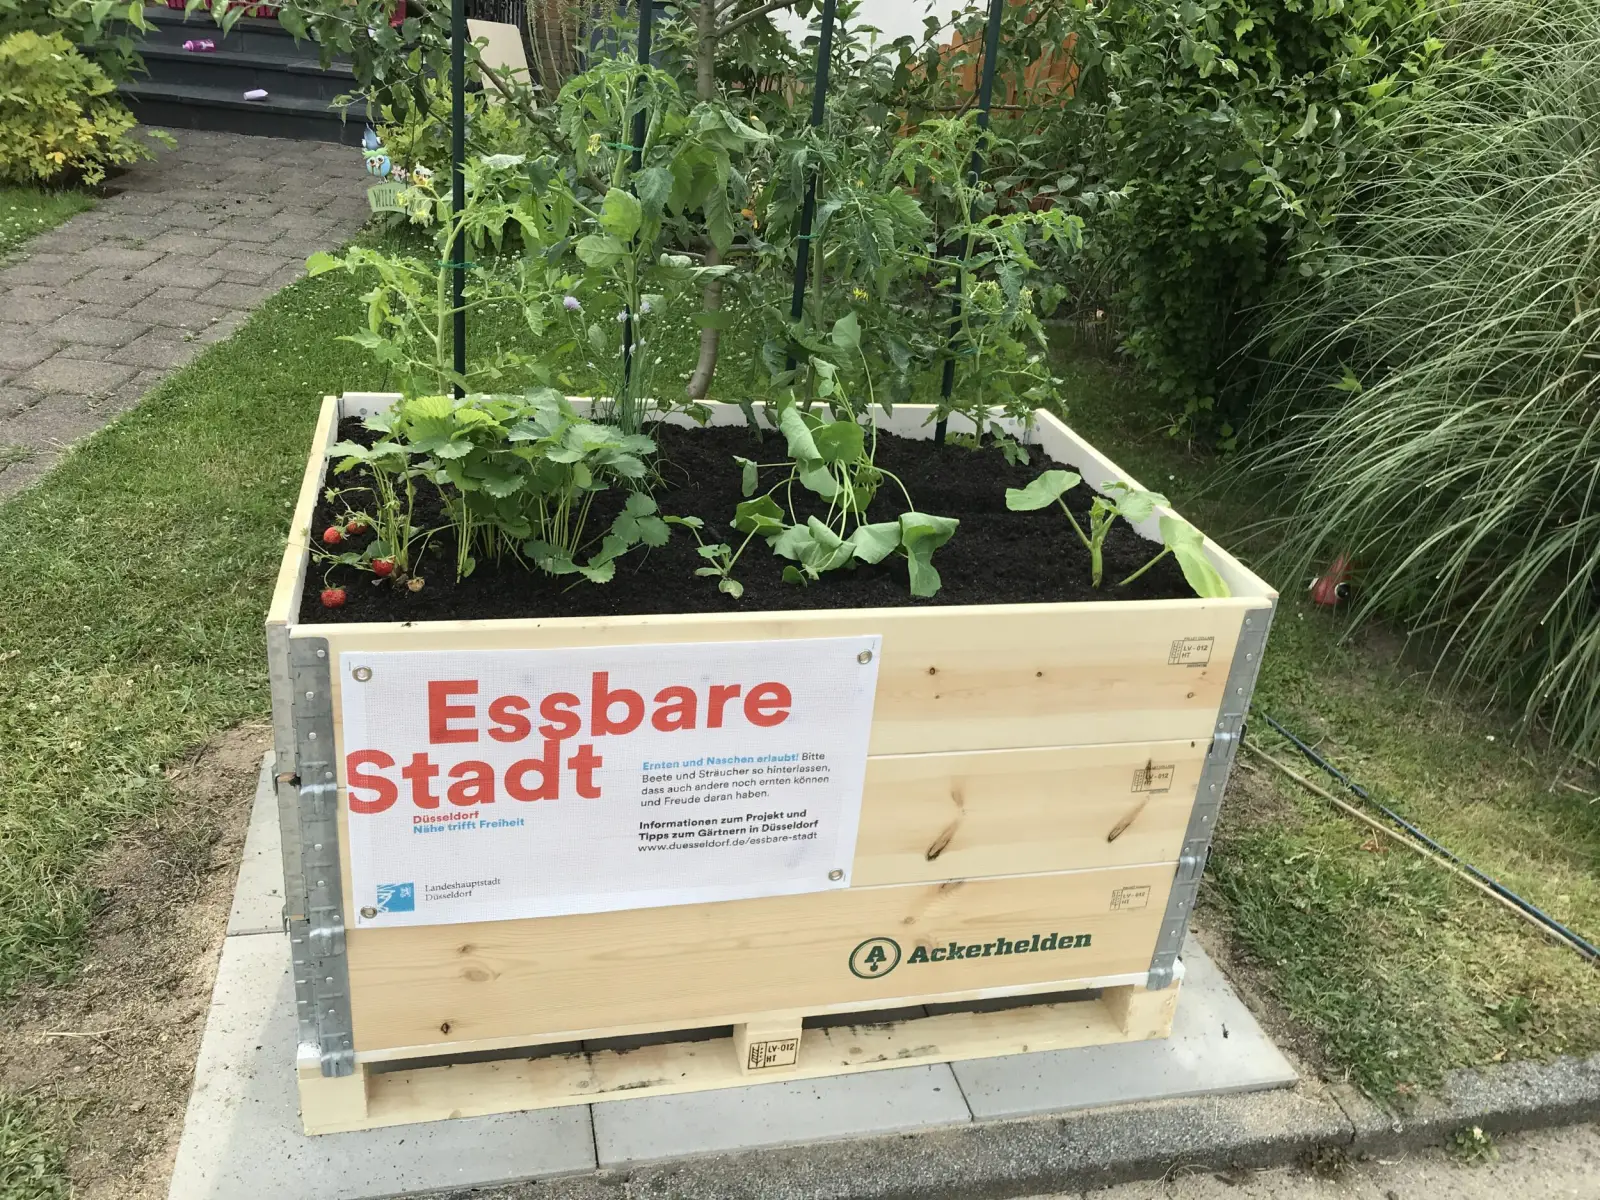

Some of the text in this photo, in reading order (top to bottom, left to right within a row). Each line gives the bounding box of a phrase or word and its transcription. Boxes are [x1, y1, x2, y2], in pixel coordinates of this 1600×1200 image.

[428, 671, 792, 744] Essbare
[642, 752, 825, 771] Ernten und Naschen erlaubt! Bitte
[346, 739, 603, 814] Stadt
[642, 774, 673, 784] Beete
[676, 770, 696, 780] und
[699, 767, 749, 778] Sträucher
[766, 764, 831, 774] hinterlassen,
[641, 775, 829, 795] dass auch andere noch ernten können
[640, 790, 770, 807] und Freude daran haben.
[413, 810, 480, 824] Düsseldorf
[413, 818, 525, 834] Nähe trifft Freiheit
[639, 808, 807, 830] Informationen zum Projekt und
[638, 820, 819, 842] Tipps zum Gärtnern in Düsseldorf
[638, 831, 818, 852] www.duesseldorf.de/essbare-stadt
[425, 877, 501, 892] Landeshauptstadt
[425, 889, 472, 901] Düsseldorf
[907, 932, 1092, 964] Ackerhelden
[768, 1043, 795, 1053] LV-012
[766, 1054, 777, 1062] HT
